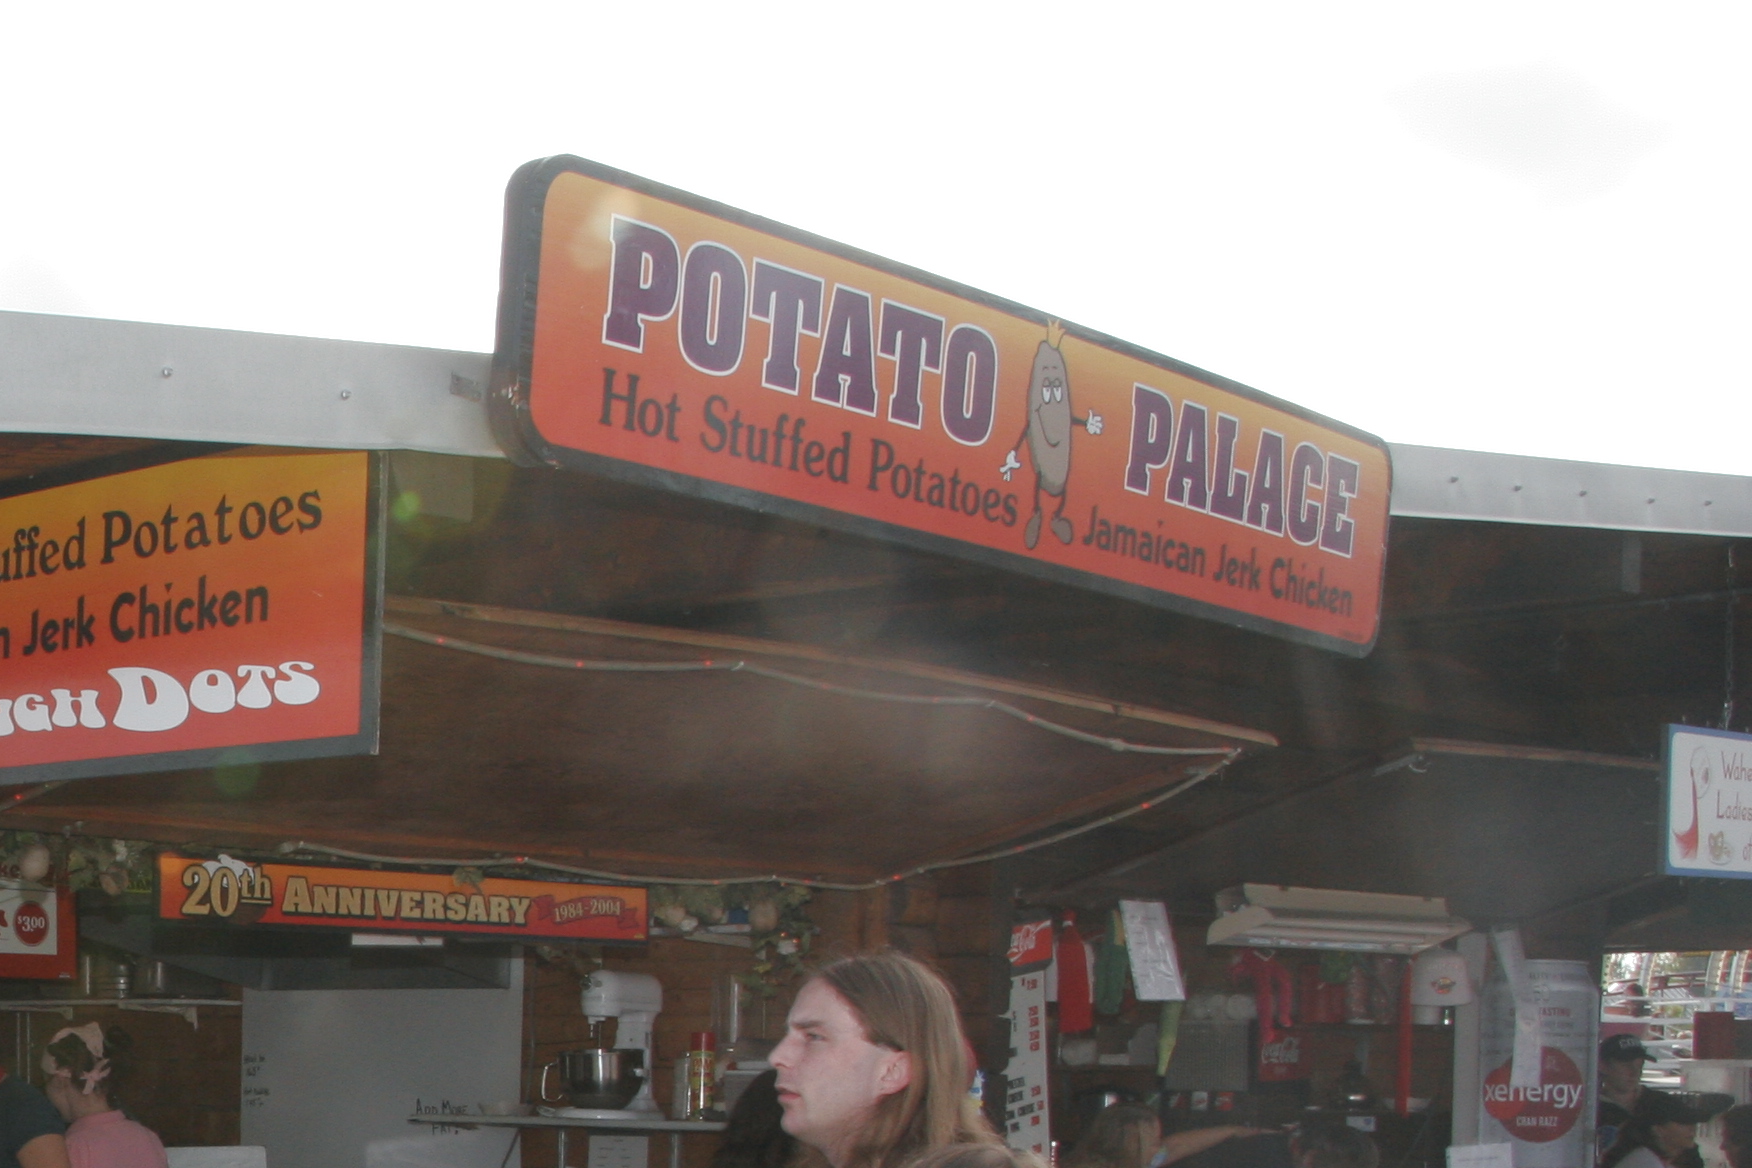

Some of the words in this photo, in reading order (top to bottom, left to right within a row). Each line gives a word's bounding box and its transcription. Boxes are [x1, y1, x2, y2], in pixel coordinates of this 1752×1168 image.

[602, 214, 998, 446] POTATO
[1124, 382, 1360, 558] PALACE
[100, 489, 324, 565] Potatoes
[600, 367, 681, 442] Hot
[700, 395, 851, 485] Stuffed
[868, 439, 1019, 527] Potatoes
[1082, 505, 1205, 578] Jamaican
[1213, 546, 1261, 592] Jerk
[1269, 558, 1353, 619] Chicken
[23, 595, 95, 656] Jerk
[109, 574, 270, 642] Chicken
[107, 661, 320, 731] DOTS
[180, 863, 272, 917] 20th
[281, 877, 531, 925] ANNIVERSARY
[554, 899, 621, 922] 1984-2004
[1484, 1083, 1583, 1109] xenergy
